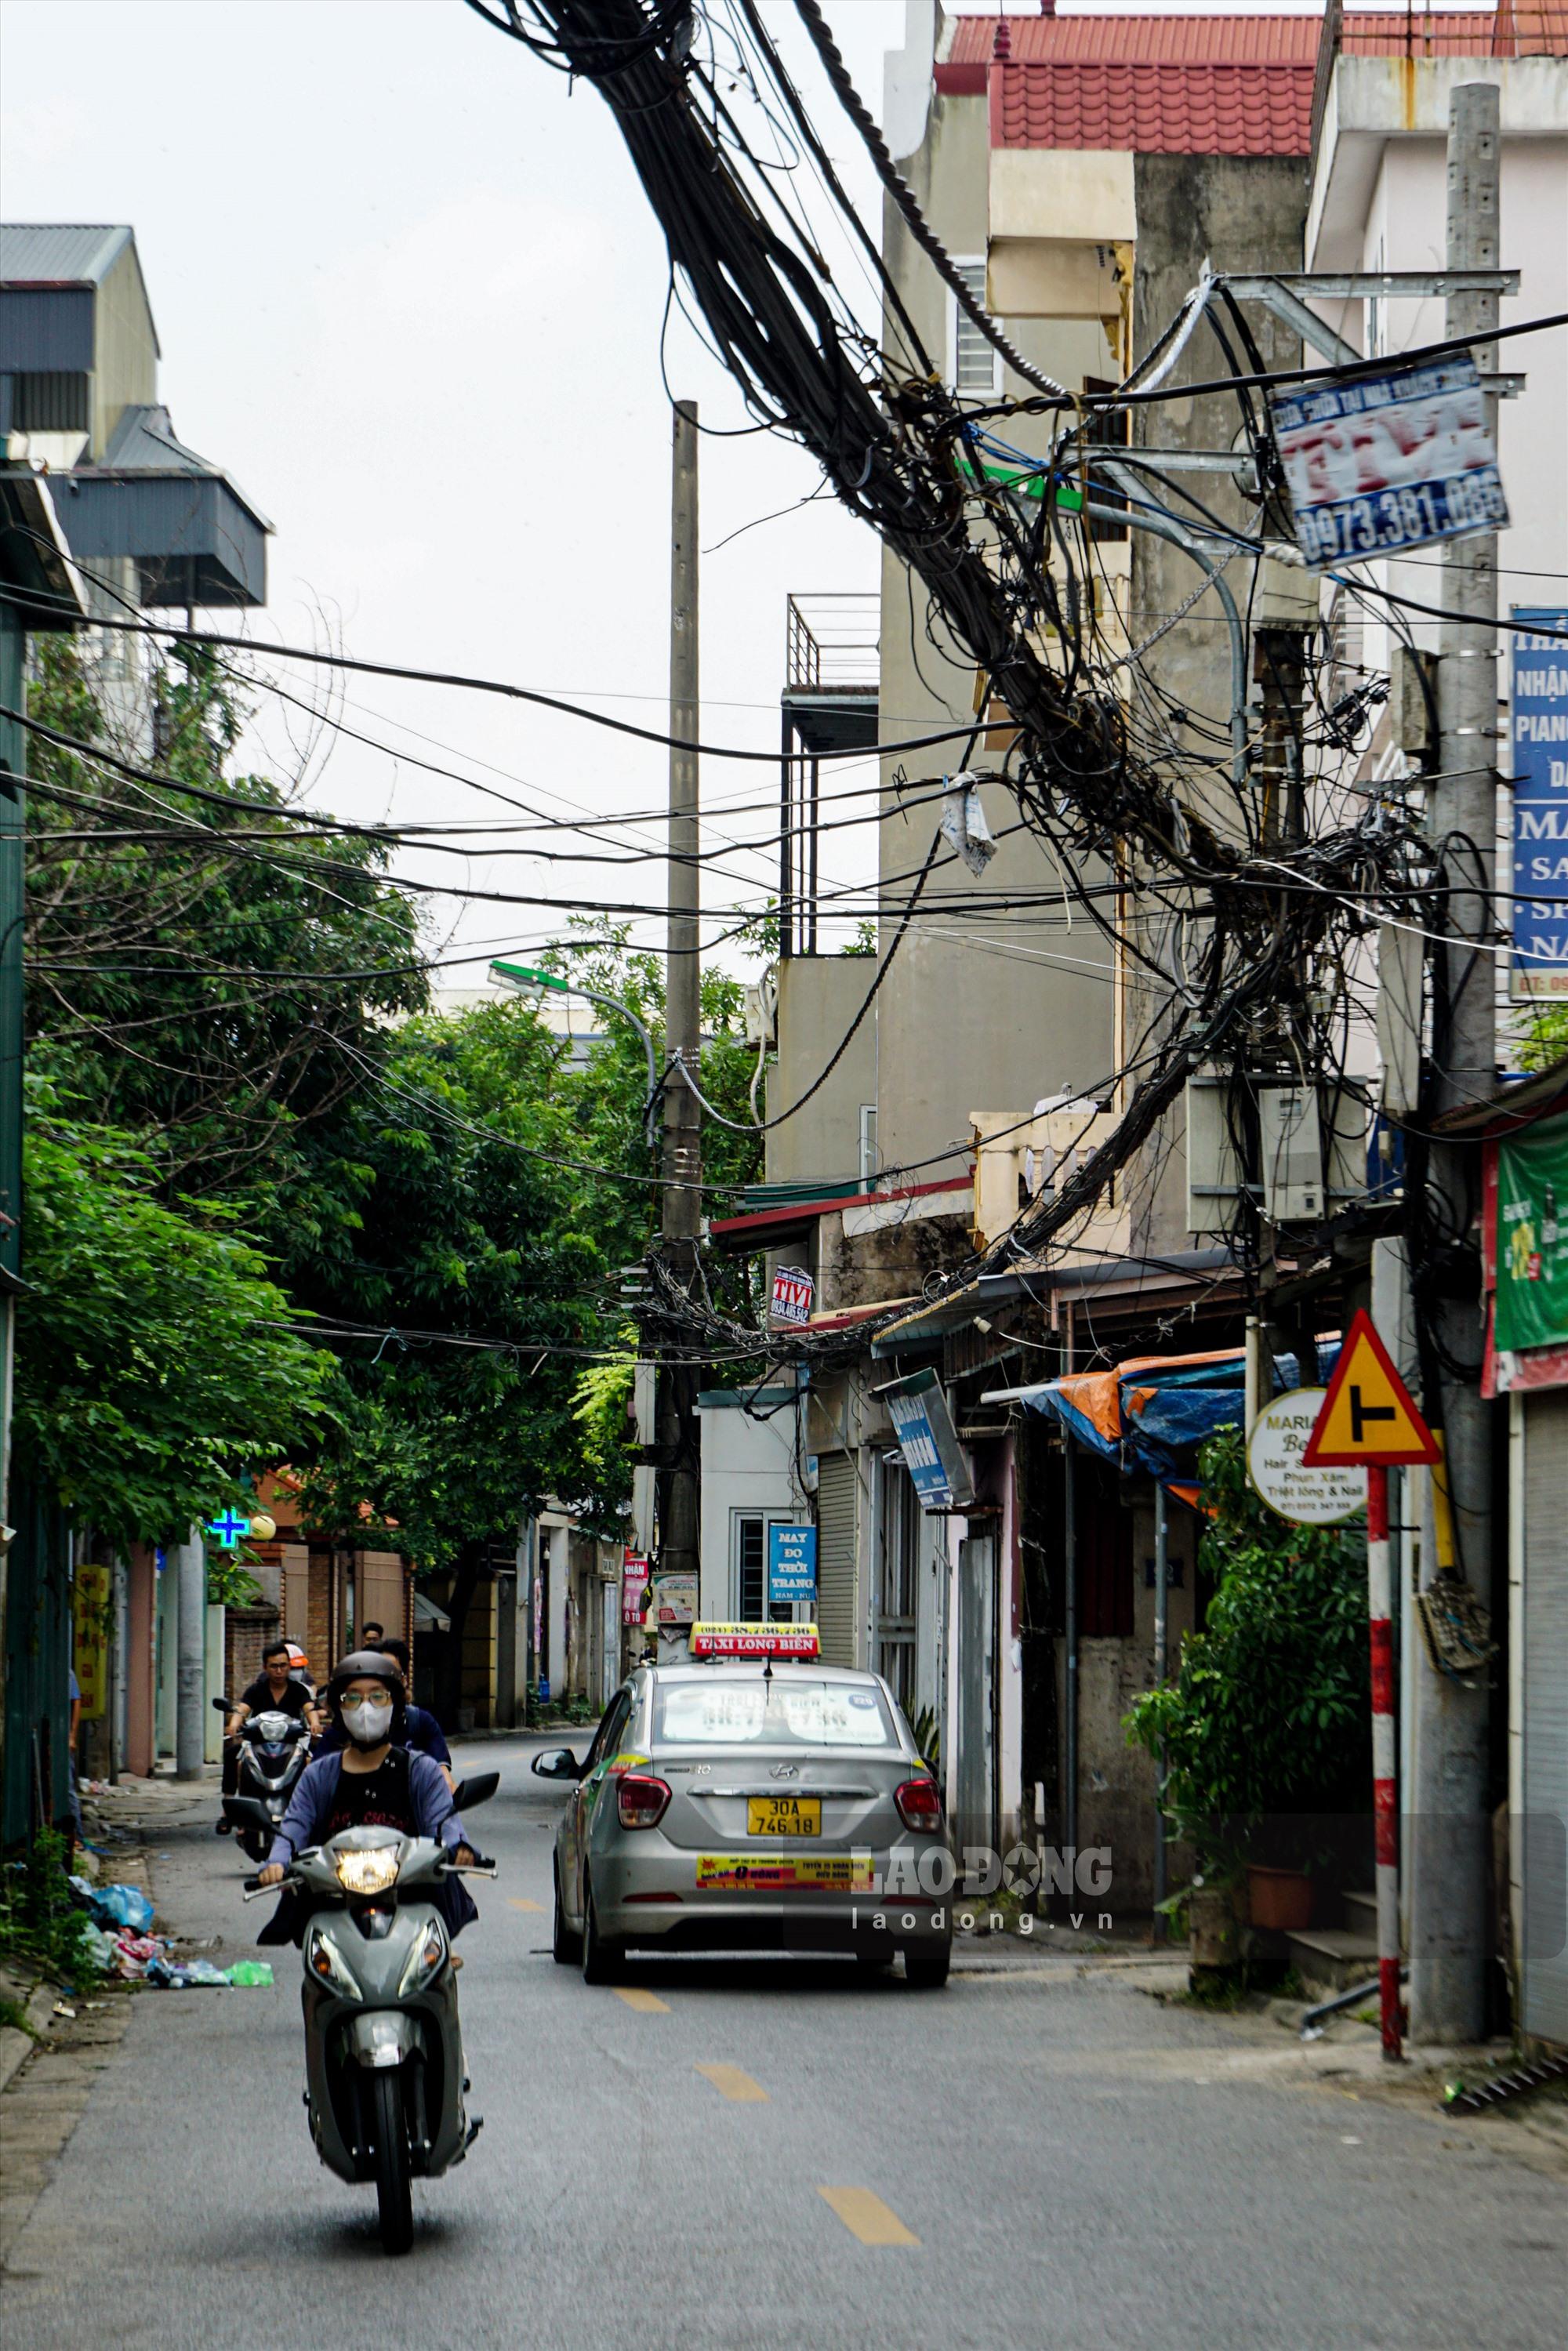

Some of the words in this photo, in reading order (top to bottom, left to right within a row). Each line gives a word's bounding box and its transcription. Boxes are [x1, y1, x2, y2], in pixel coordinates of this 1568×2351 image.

[1515, 716, 1568, 742] PIAN
[1551, 761, 1568, 787] D
[1518, 811, 1568, 840] M
[774, 1278, 811, 1308] TIVI
[1294, 1459, 1305, 1468] S
[1329, 1486, 1338, 1497] &
[779, 1533, 808, 1543] MAY
[778, 1561, 808, 1573] THỜI
[771, 1578, 814, 1588] TRANG
[699, 1638, 734, 1649] TAXI
[737, 1638, 776, 1650] LONG
[779, 1636, 813, 1650] BIÊN
[770, 1800, 800, 1816] 30A
[756, 1818, 812, 1834] 746.18
